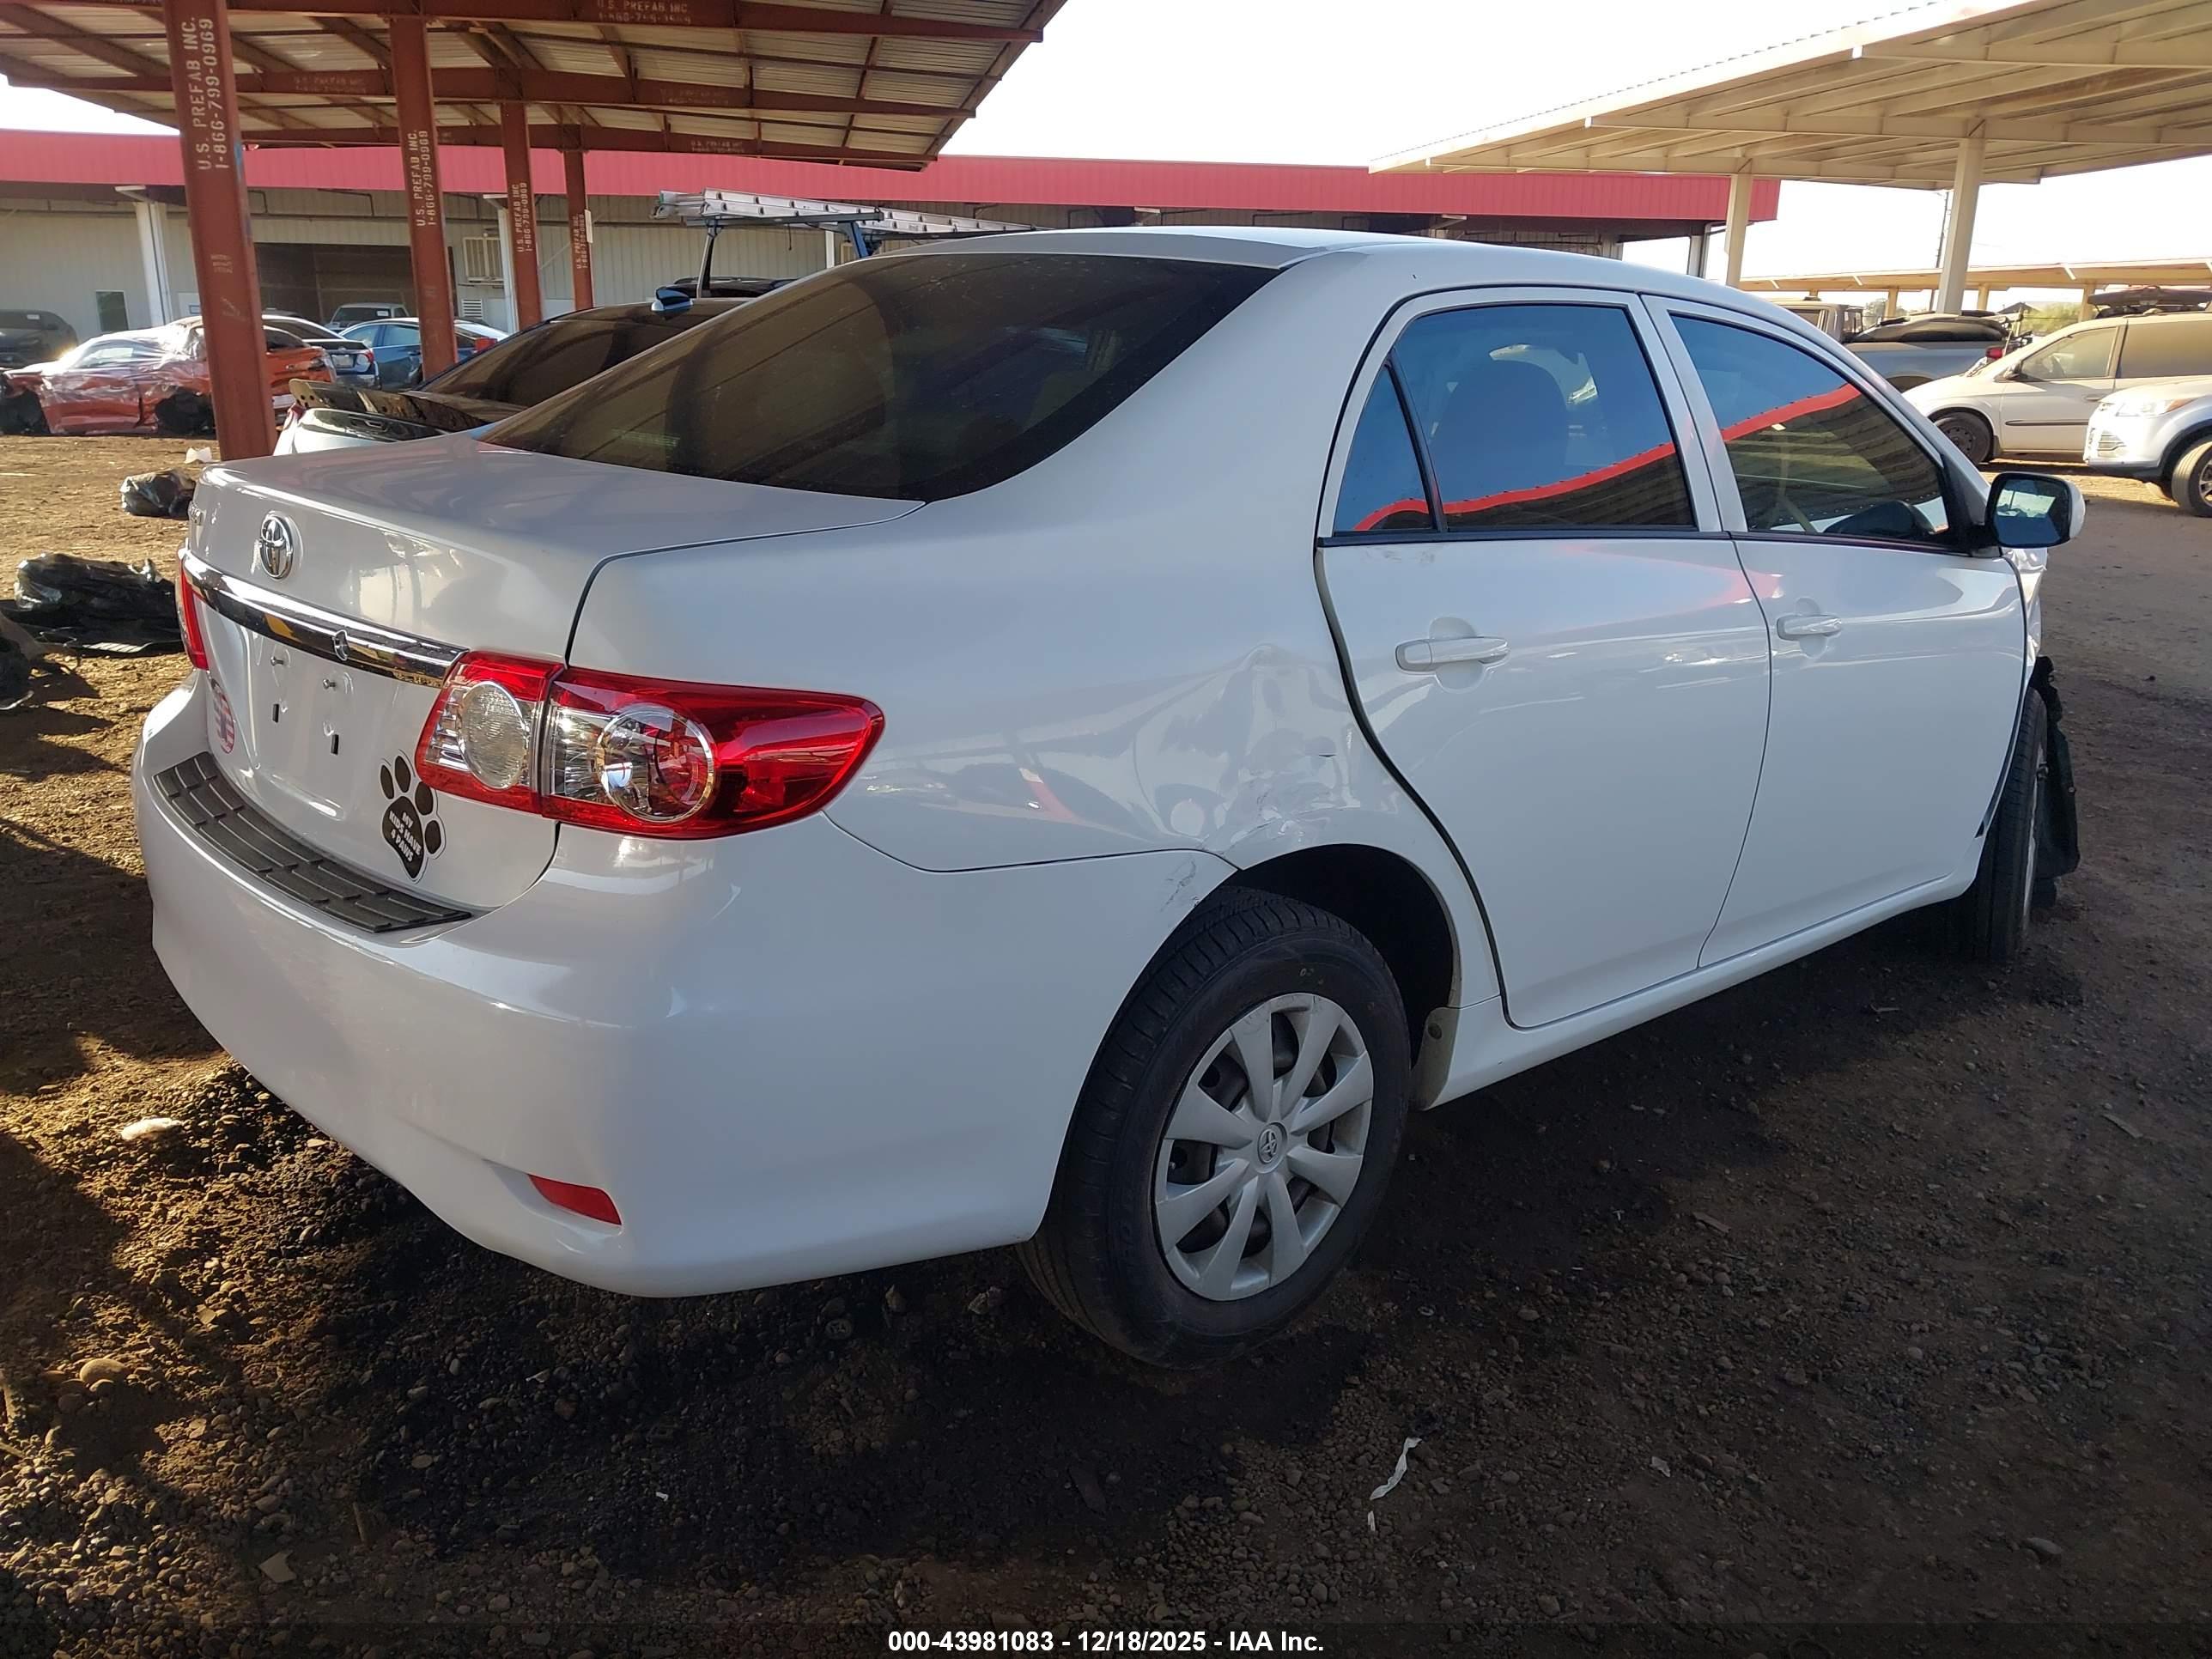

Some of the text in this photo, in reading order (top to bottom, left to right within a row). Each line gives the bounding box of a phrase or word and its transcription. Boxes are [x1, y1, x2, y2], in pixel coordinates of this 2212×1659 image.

[181, 17, 212, 170] U.S. PREFAB INC.
[199, 18, 229, 168] 1-866-799-0969
[407, 130, 426, 226] U.S. PREFAB INC.
[418, 131, 436, 225] 1-866-799-0969
[389, 810, 422, 855] KIDS HAVE
[391, 829, 413, 862] 4 PAWS
[402, 811, 413, 828] MY
